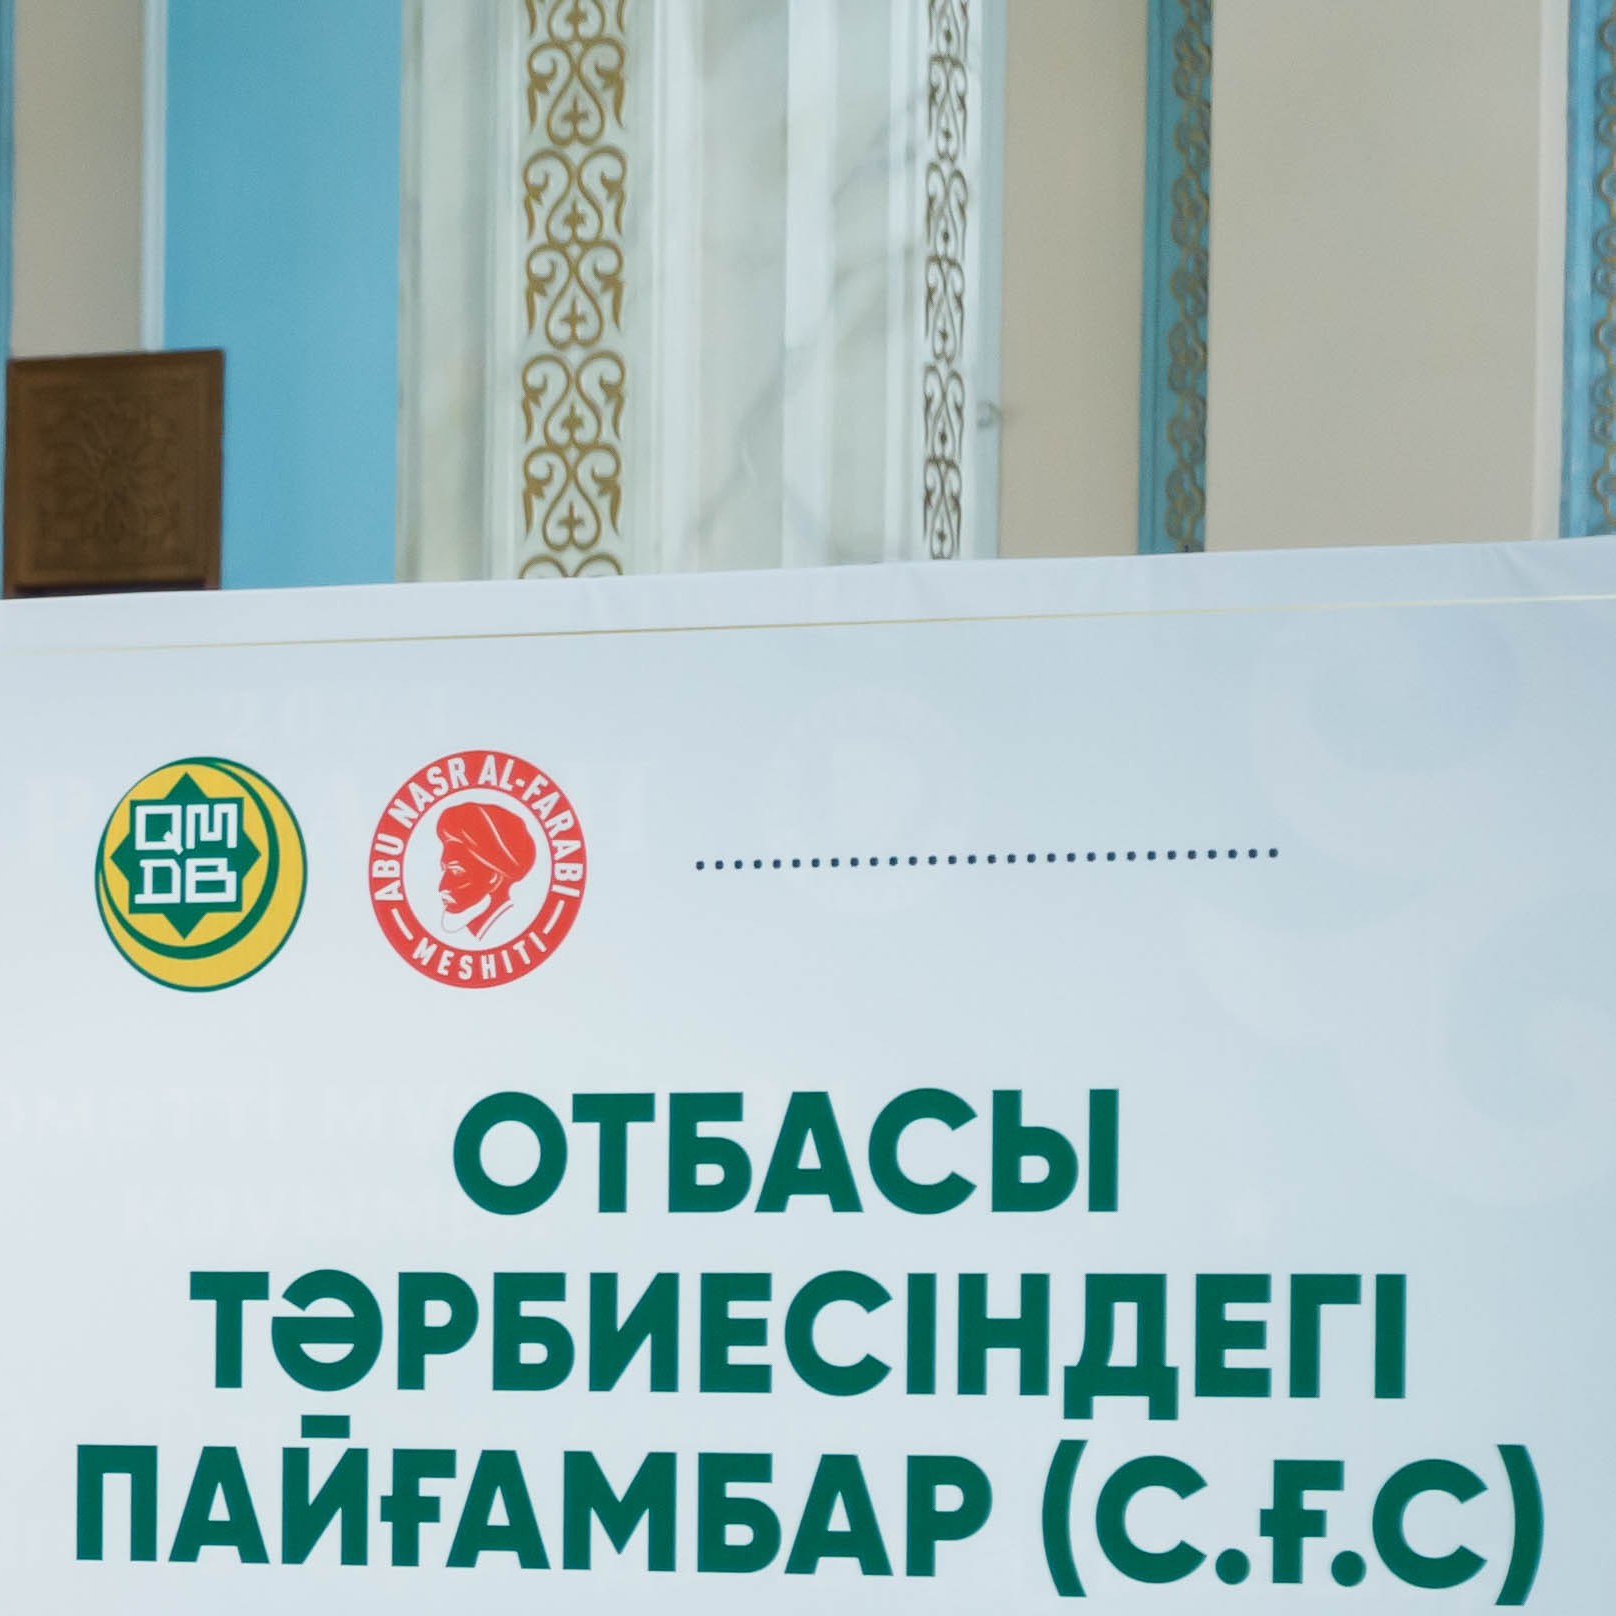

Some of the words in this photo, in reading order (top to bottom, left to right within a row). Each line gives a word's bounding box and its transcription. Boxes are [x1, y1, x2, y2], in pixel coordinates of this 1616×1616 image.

[387, 757, 469, 829] NASR
[478, 754, 583, 897] AL-FARABI
[372, 833, 405, 901] ABU
[412, 931, 547, 981] MESHITI
[453, 1088, 1119, 1217] ОТБАСЫ
[190, 1269, 1407, 1421] ТӘРБИЕСІНДЕГІ
[76, 1414, 993, 1578] ПАЙҒАМБАР
[1041, 1439, 1546, 1607] (С.Ғ.С)
